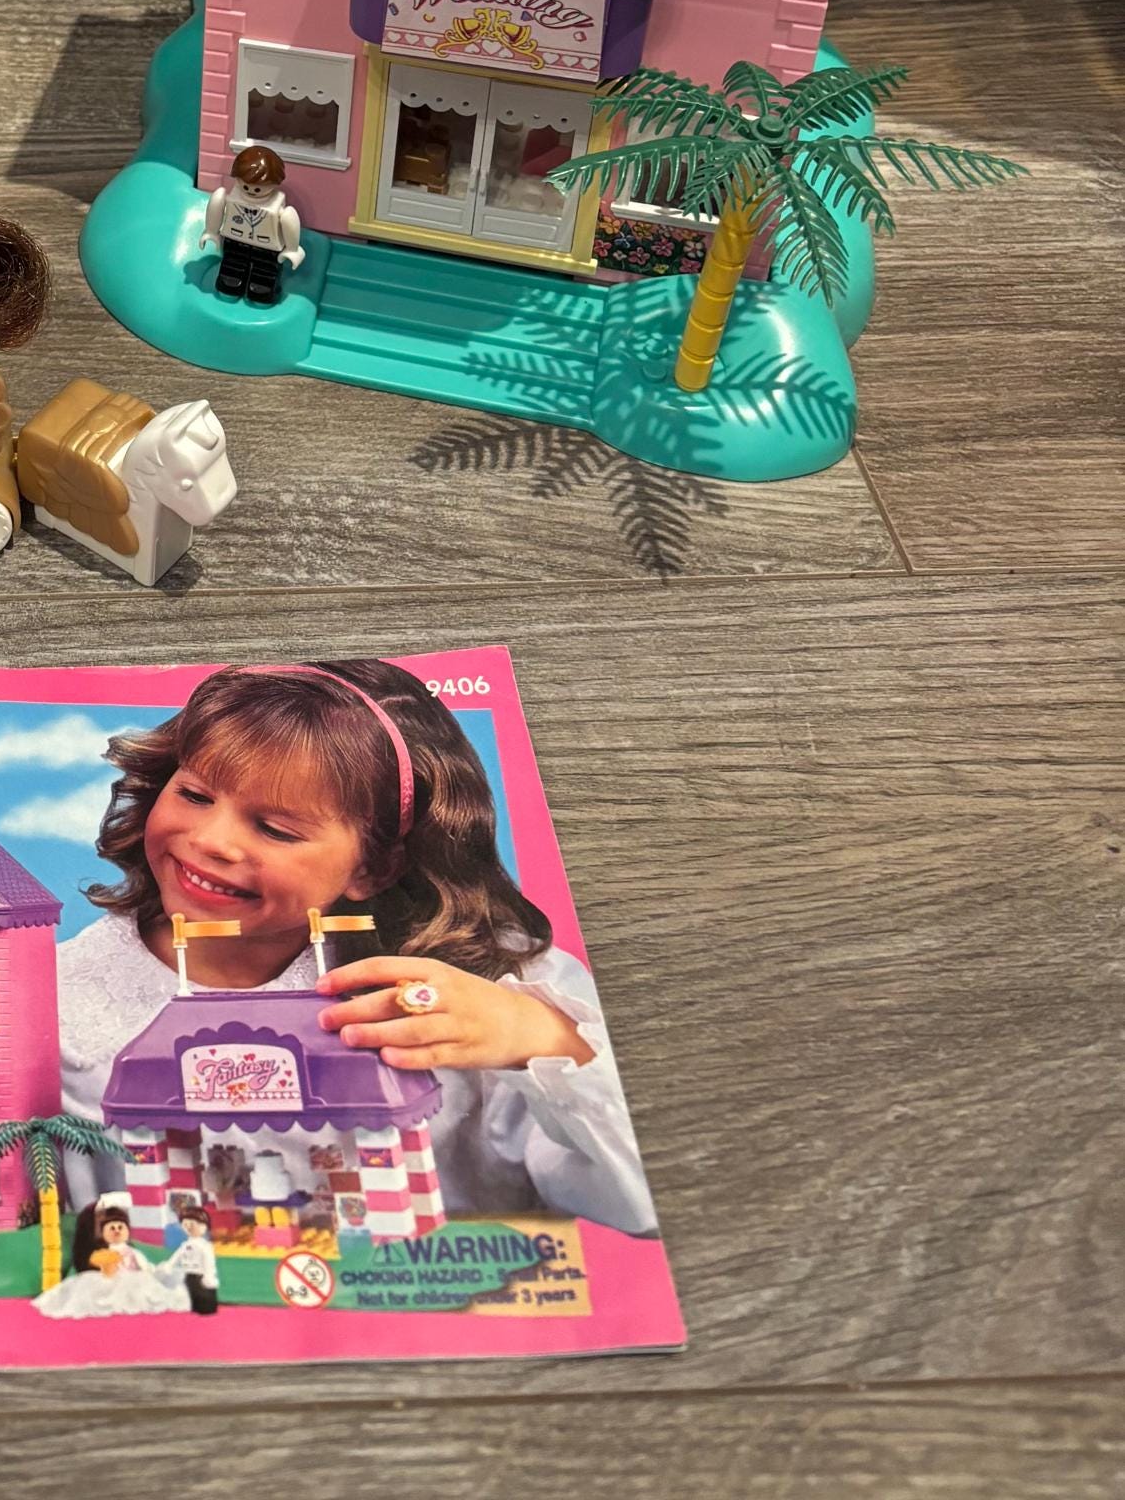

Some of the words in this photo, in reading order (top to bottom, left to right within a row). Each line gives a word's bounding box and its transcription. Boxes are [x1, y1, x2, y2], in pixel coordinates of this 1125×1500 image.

[425, 675, 491, 697] 9406
[196, 1058, 280, 1100] Fantasy
[403, 1233, 567, 1264] WARNING:
[340, 1270, 414, 1286] CHOKING
[417, 1268, 482, 1284] HAZARD
